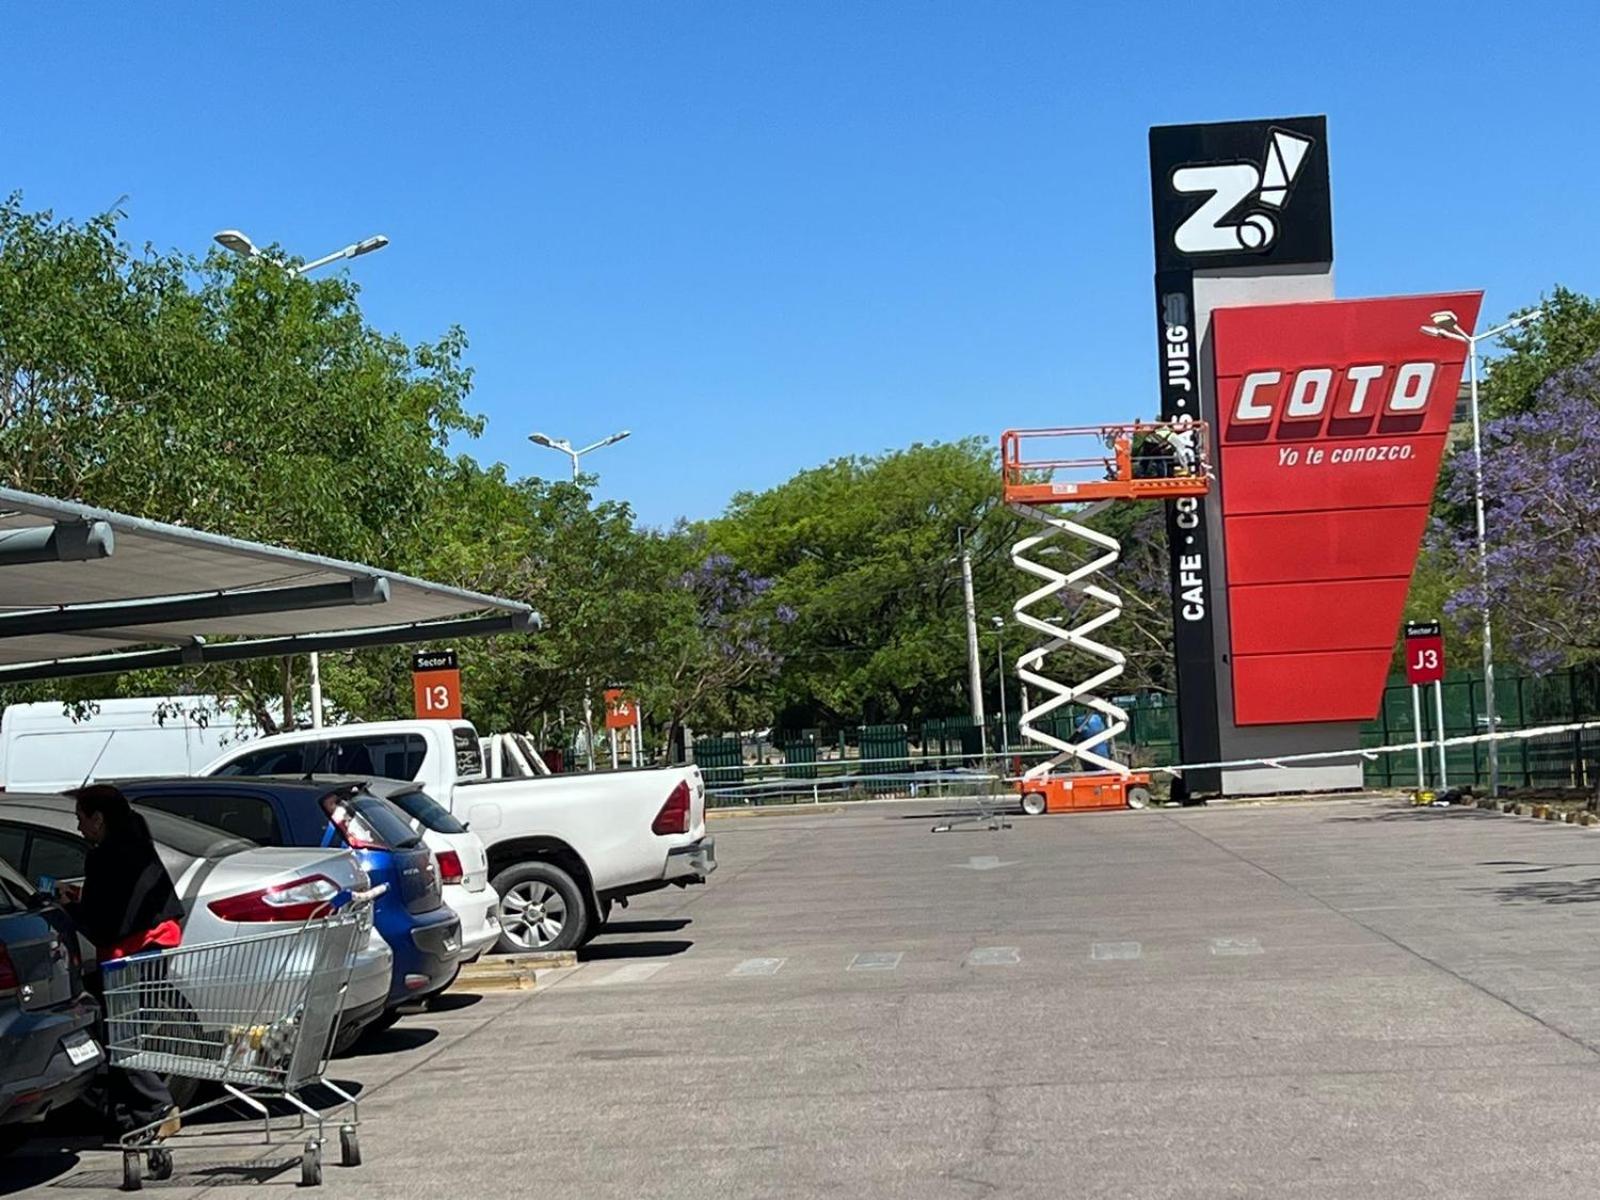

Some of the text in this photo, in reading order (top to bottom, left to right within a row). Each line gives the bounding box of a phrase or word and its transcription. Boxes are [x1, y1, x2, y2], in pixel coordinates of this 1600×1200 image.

[1234, 362, 1436, 420] COTO
[1278, 445, 1416, 466] Yo te conozco.
[1180, 554, 1204, 620] CAFE
[1407, 627, 1432, 636] Sector
[418, 658, 446, 667] Sector
[1412, 649, 1438, 670] J3
